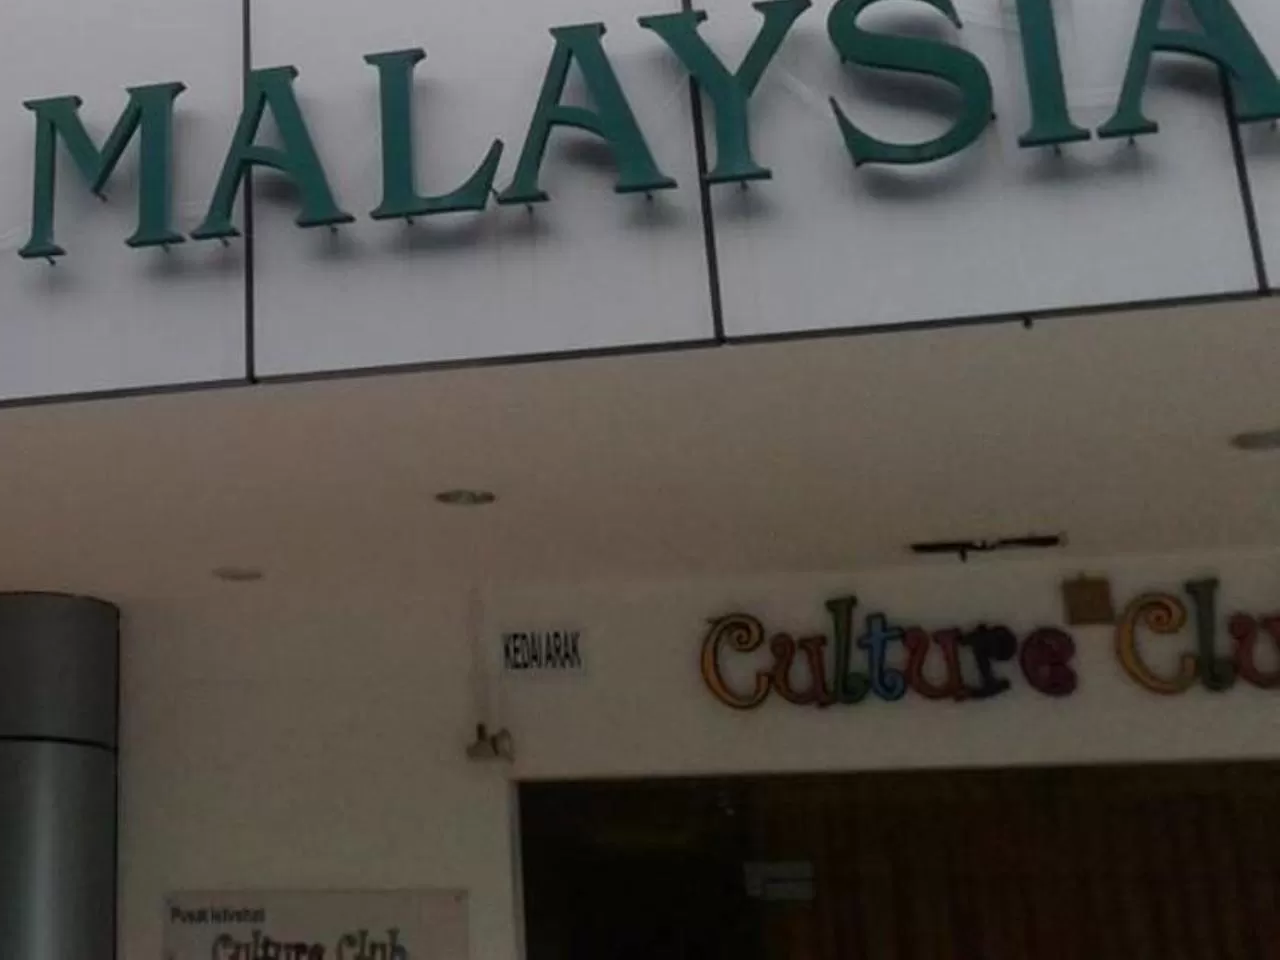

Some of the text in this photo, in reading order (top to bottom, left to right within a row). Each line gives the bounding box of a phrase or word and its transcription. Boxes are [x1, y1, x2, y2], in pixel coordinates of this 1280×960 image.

[503, 631, 582, 669] KEDAI ARAK
[700, 595, 1078, 710] Culture
